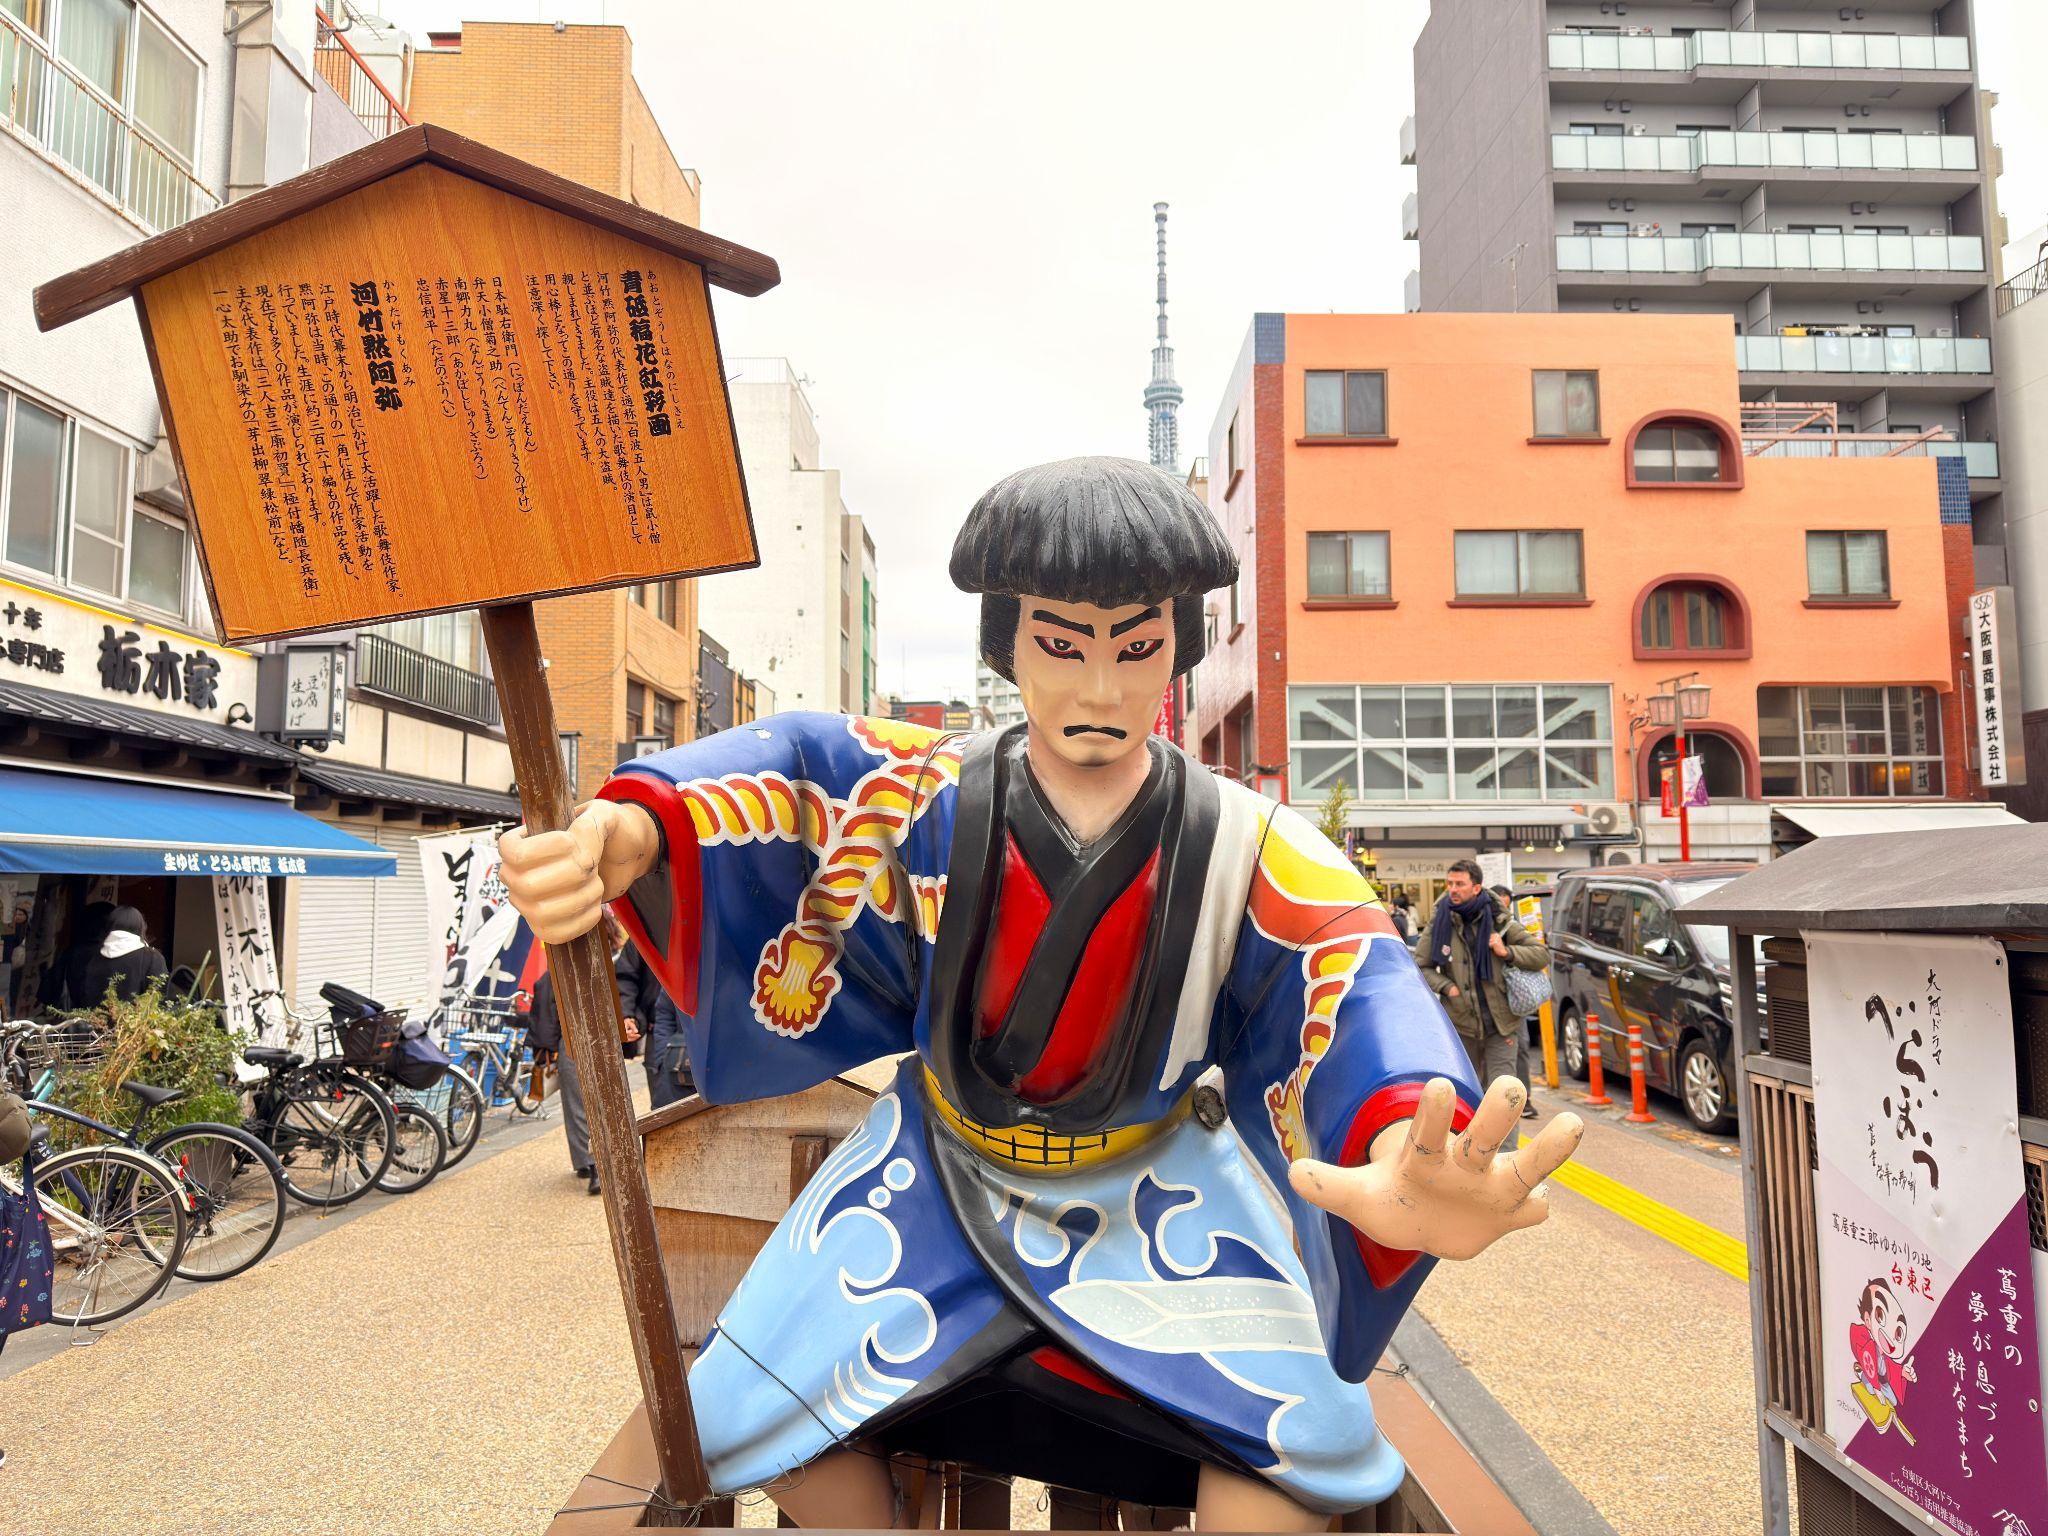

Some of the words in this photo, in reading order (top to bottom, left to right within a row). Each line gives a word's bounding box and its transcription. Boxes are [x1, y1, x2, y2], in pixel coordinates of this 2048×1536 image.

[349, 281, 403, 412] 河竹黙阿弥
[383, 279, 416, 388] かわたけもくあみ
[97, 624, 221, 709] 栃木家
[1979, 611, 2001, 781] 大阪屋商事株式会社
[1925, 968, 1942, 1066] 大河ドラマ
[1865, 992, 1939, 1190] べらぼう
[1832, 1213, 1933, 1272] 蔦屋重三郎ゆかりの地
[1890, 1261, 1935, 1301] 台東区
[1997, 1267, 2023, 1366] 蔦重の
[1947, 1347, 1973, 1478] 粋なまち
[1968, 1290, 1998, 1464] 夢が息づく
[1901, 1465, 1961, 1511] 台東区大河ドラマ
